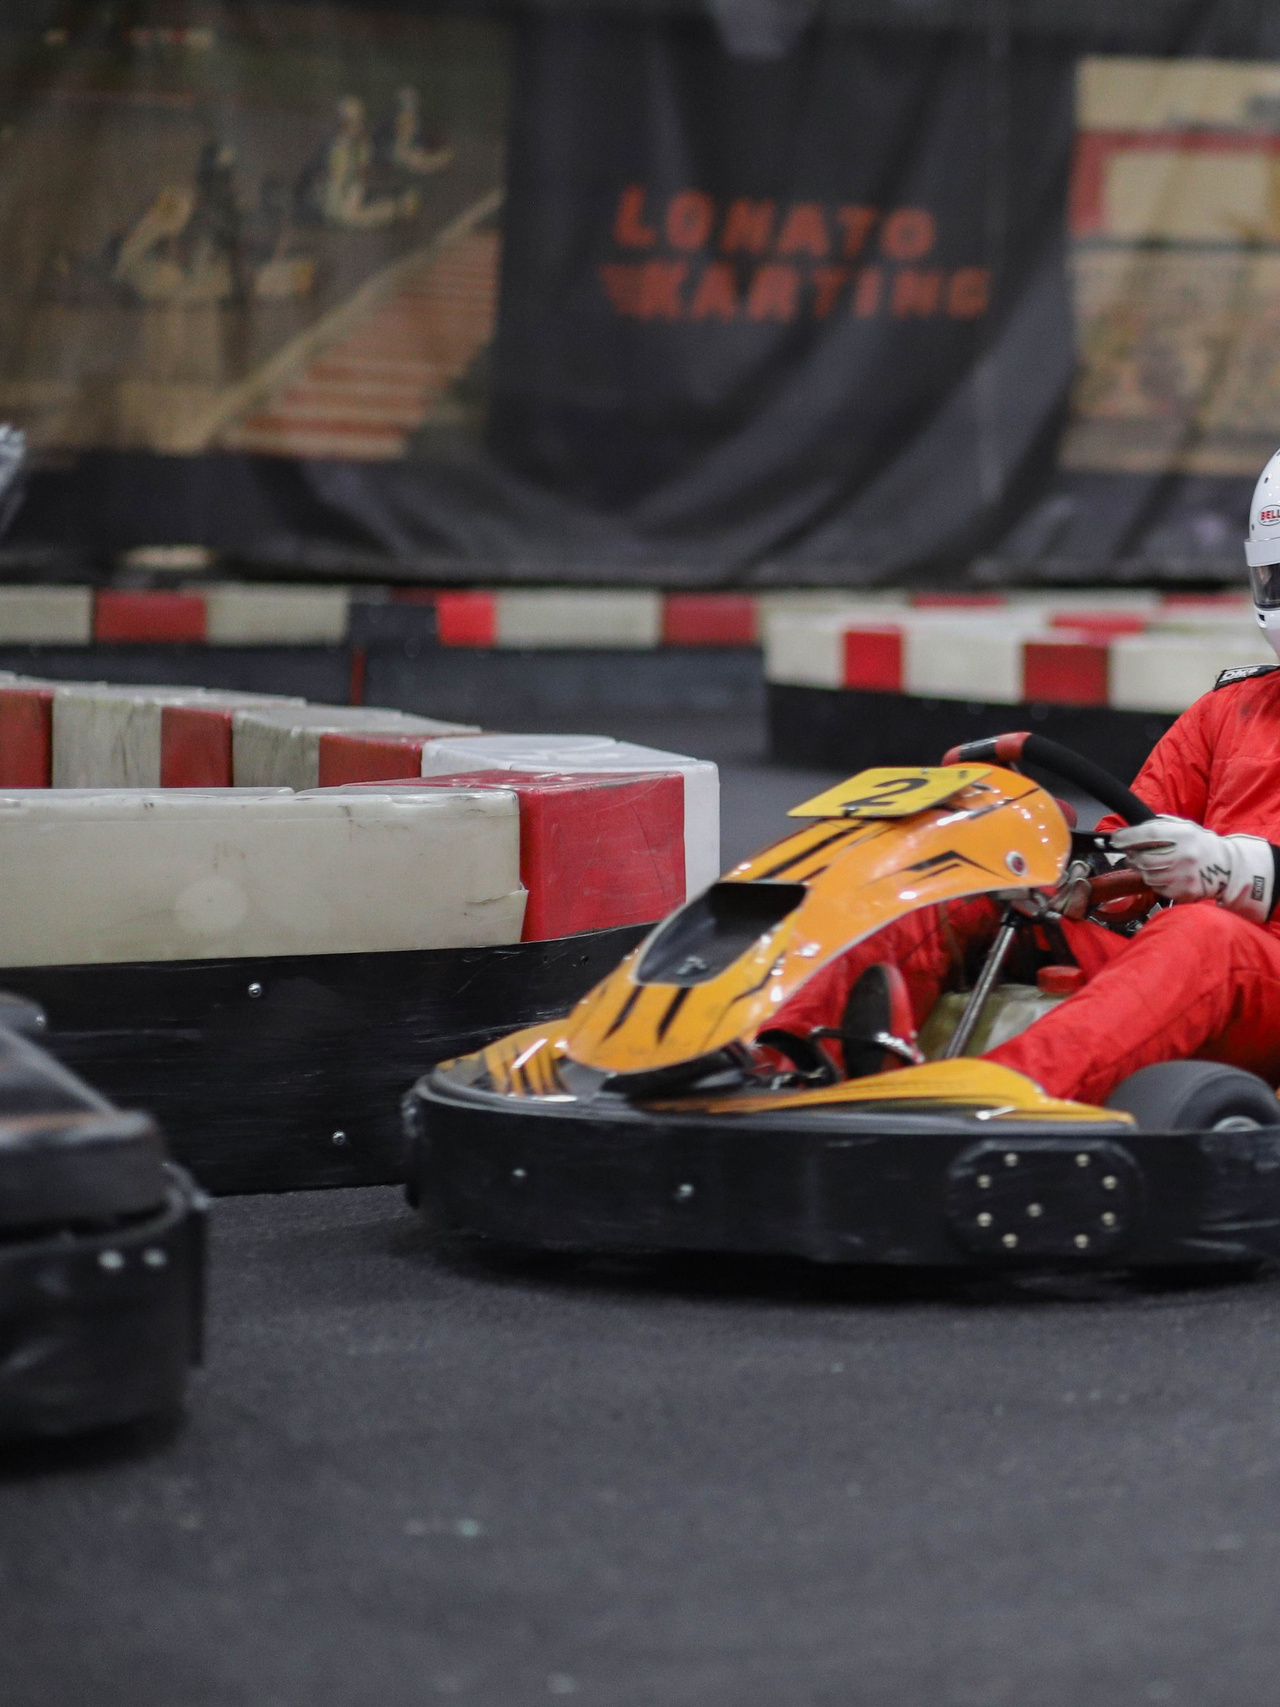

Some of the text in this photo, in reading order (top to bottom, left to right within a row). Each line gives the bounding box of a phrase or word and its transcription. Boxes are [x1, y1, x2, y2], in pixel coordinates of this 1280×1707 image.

[612, 184, 937, 261] LONATO
[602, 258, 992, 322] KARTING
[839, 777, 929, 808] 2
